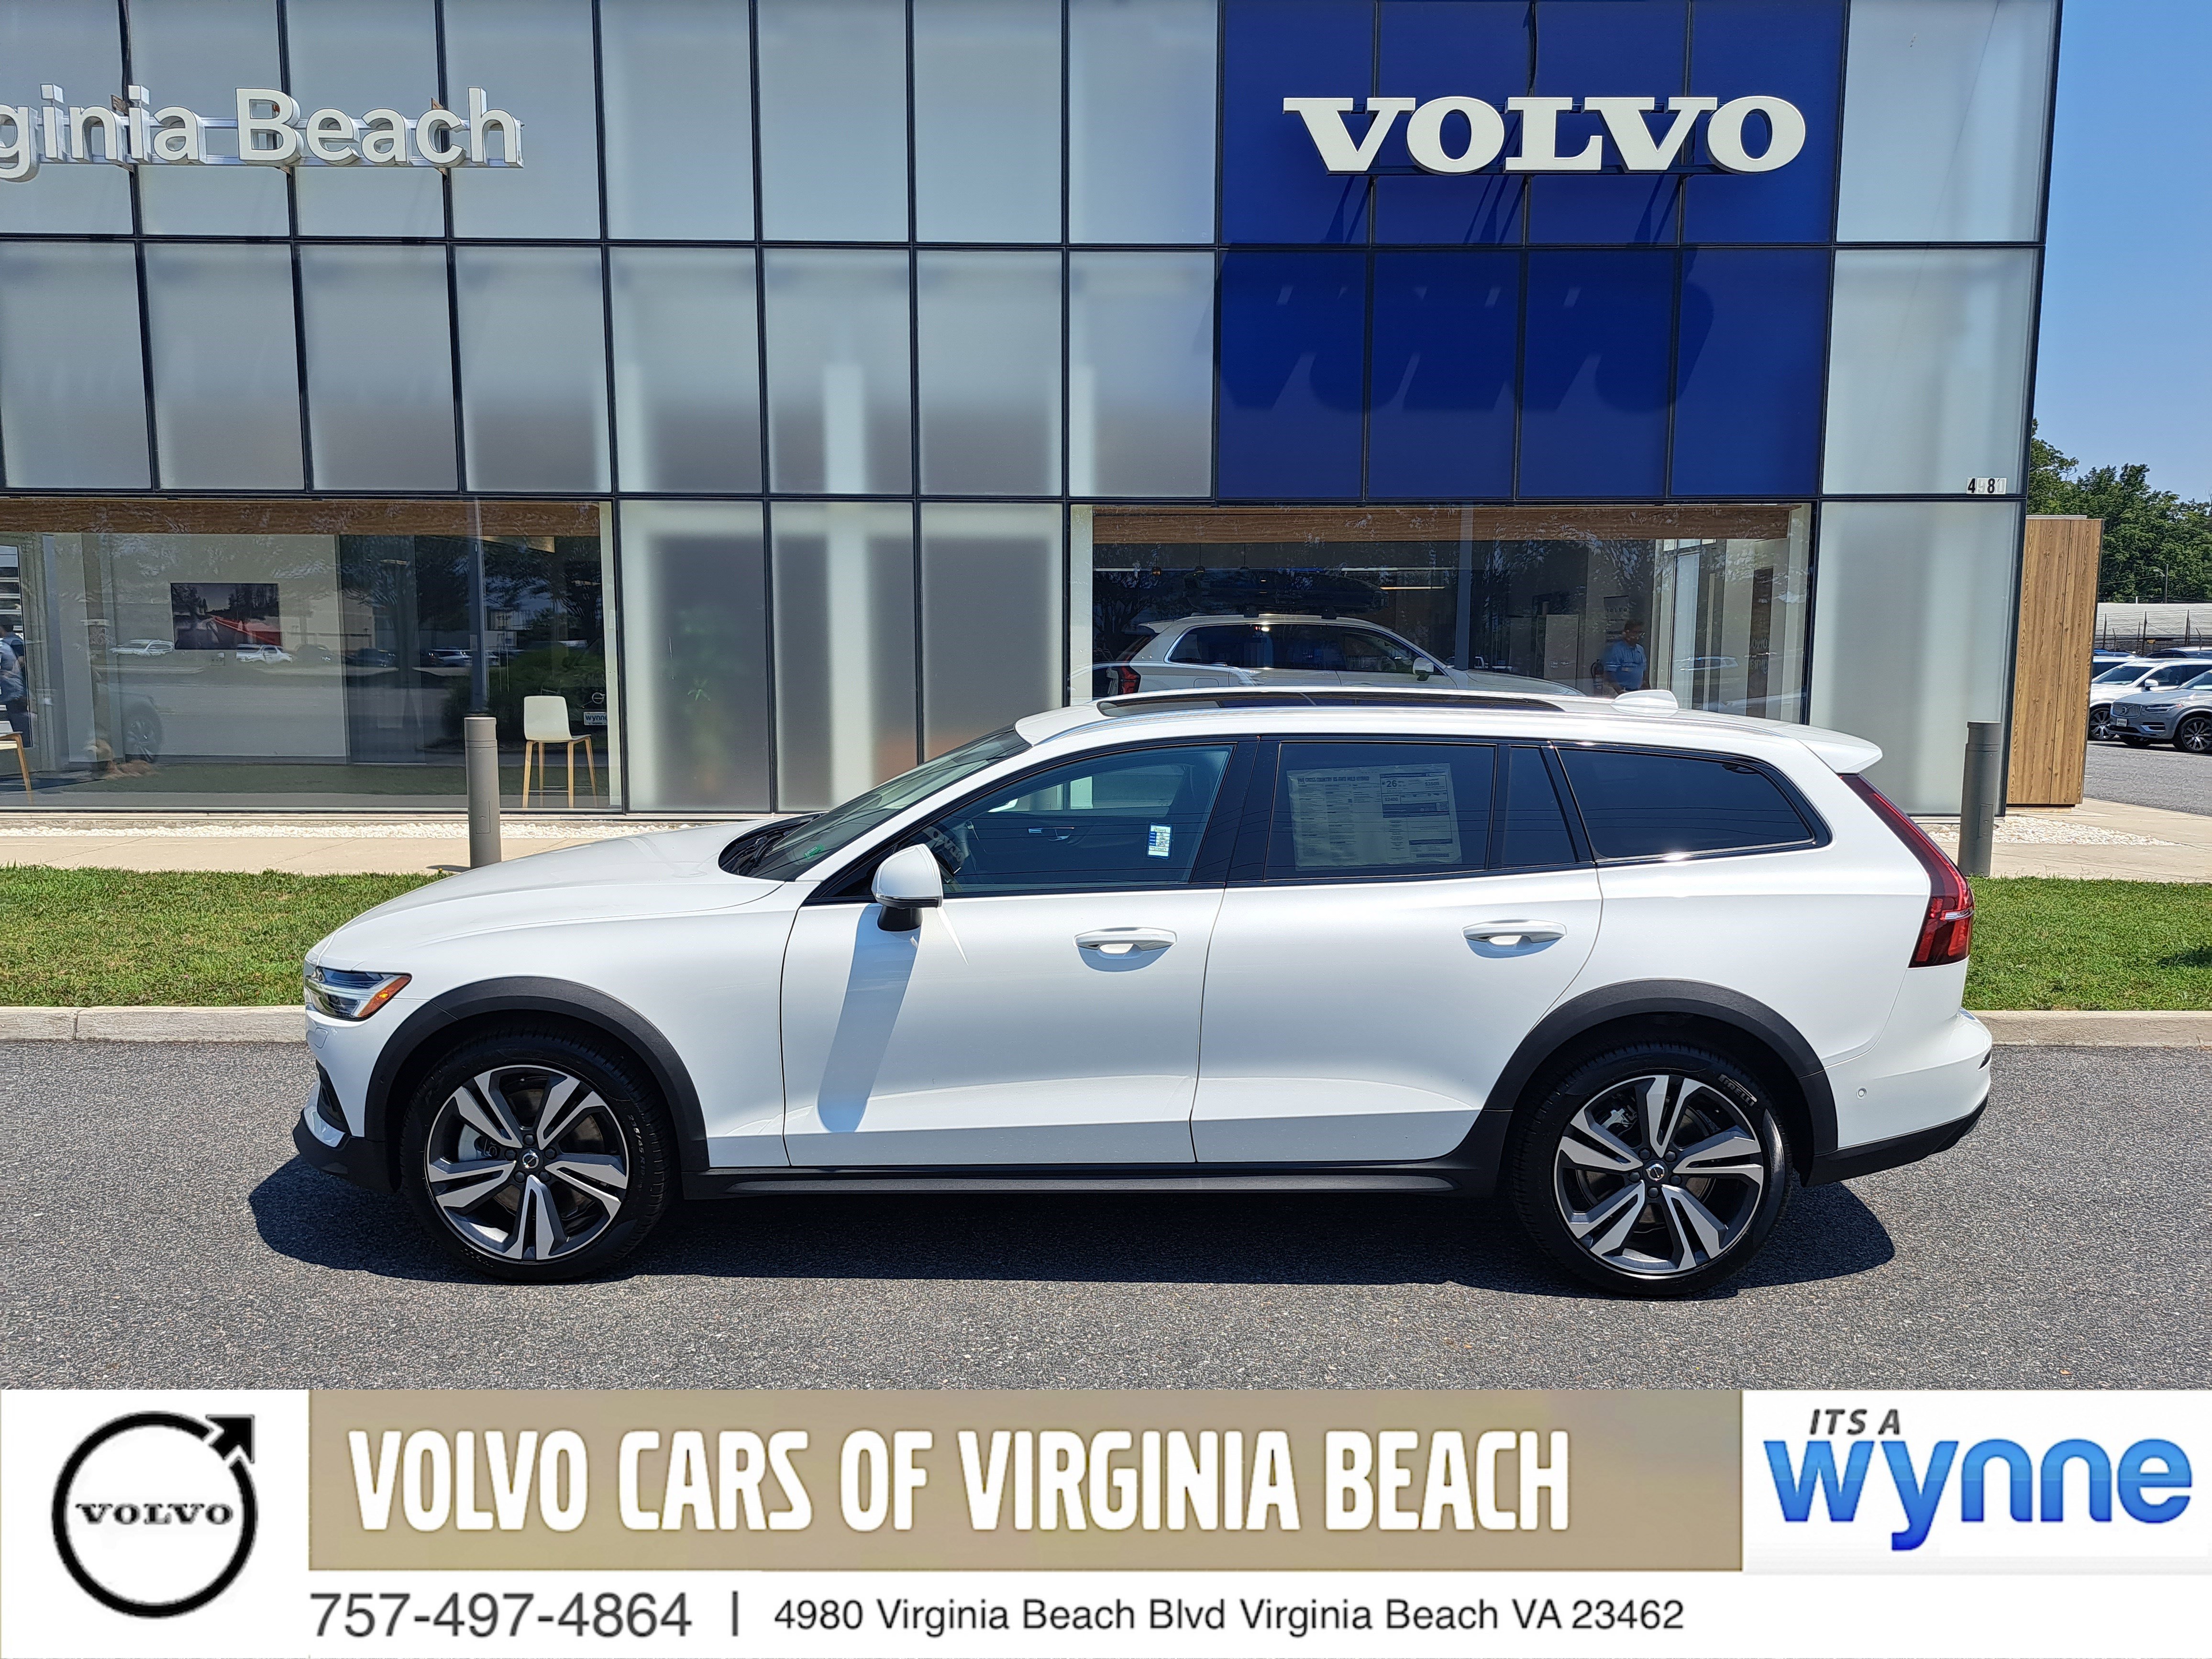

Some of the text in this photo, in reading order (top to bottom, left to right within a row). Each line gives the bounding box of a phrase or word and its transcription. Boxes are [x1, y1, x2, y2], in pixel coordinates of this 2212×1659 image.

[235, 87, 523, 168] Beach
[1283, 96, 1806, 173] VOLVO
[1718, 1074, 1757, 1107] PIRELLI
